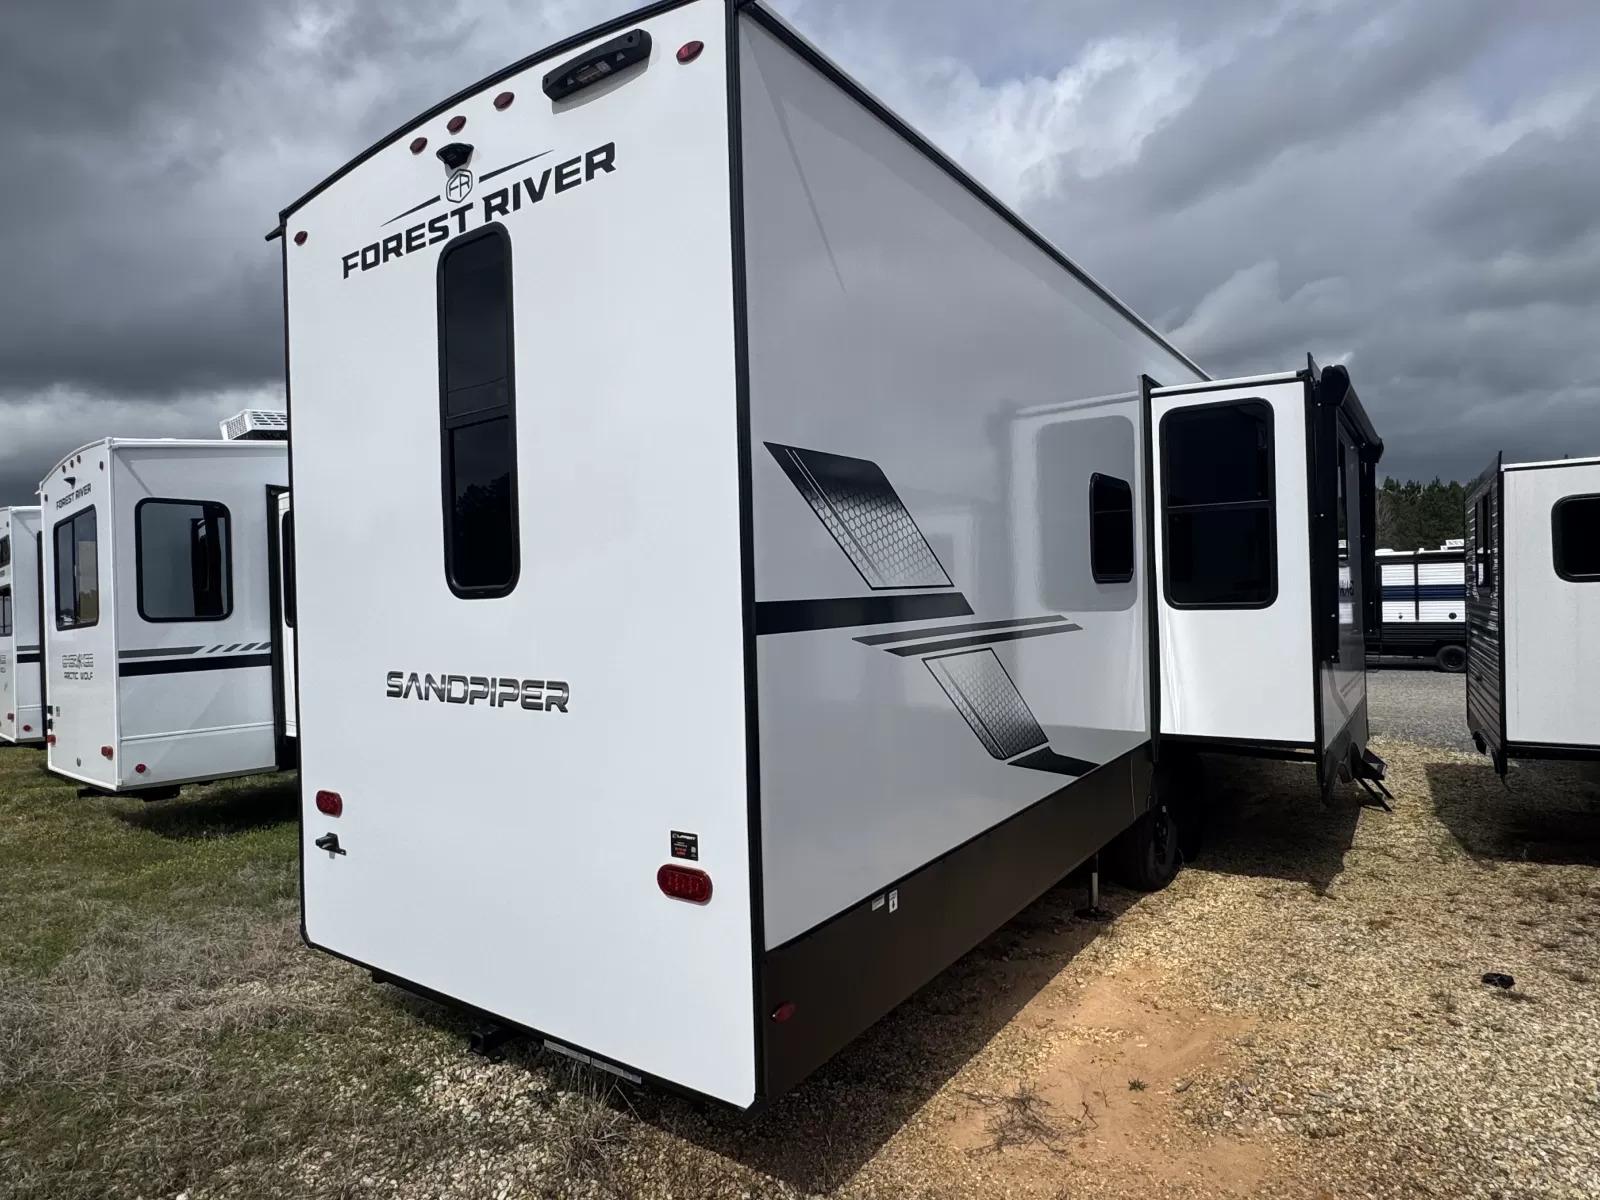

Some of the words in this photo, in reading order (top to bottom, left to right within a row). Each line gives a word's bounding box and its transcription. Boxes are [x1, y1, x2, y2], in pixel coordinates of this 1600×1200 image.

[341, 202, 473, 279] FOREST
[482, 142, 616, 223] RIVER
[56, 491, 74, 510] FOREST
[75, 482, 91, 500] RIVER
[386, 671, 570, 713] SANDPIPER
